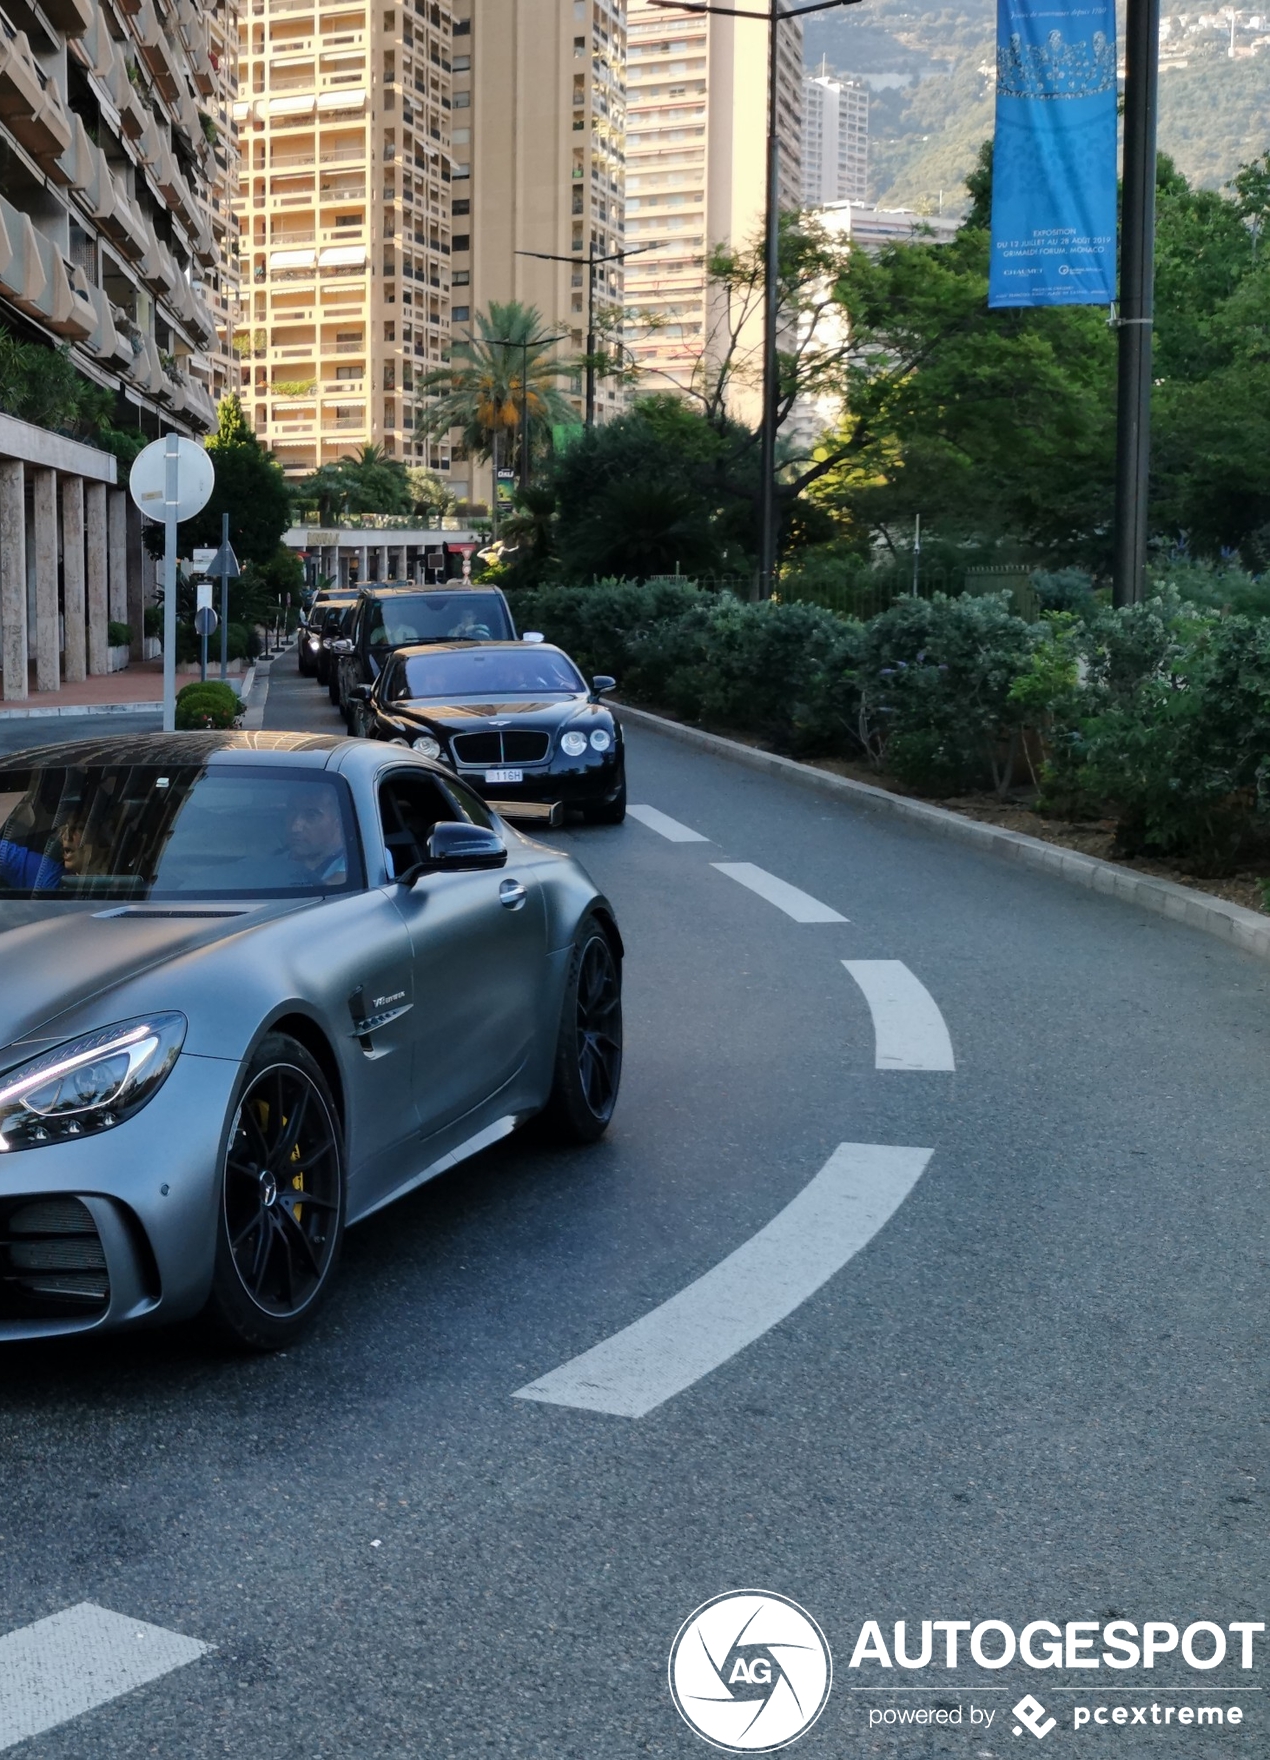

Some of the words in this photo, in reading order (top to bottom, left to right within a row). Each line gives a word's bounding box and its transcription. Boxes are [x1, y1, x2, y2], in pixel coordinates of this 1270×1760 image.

[1033, 228, 1076, 237] EXPOSITION
[1021, 239, 1045, 247] JUILLET
[1092, 236, 1112, 244] 2019
[1003, 249, 1038, 258] GRIMALDI
[1070, 246, 1105, 254] MONACO
